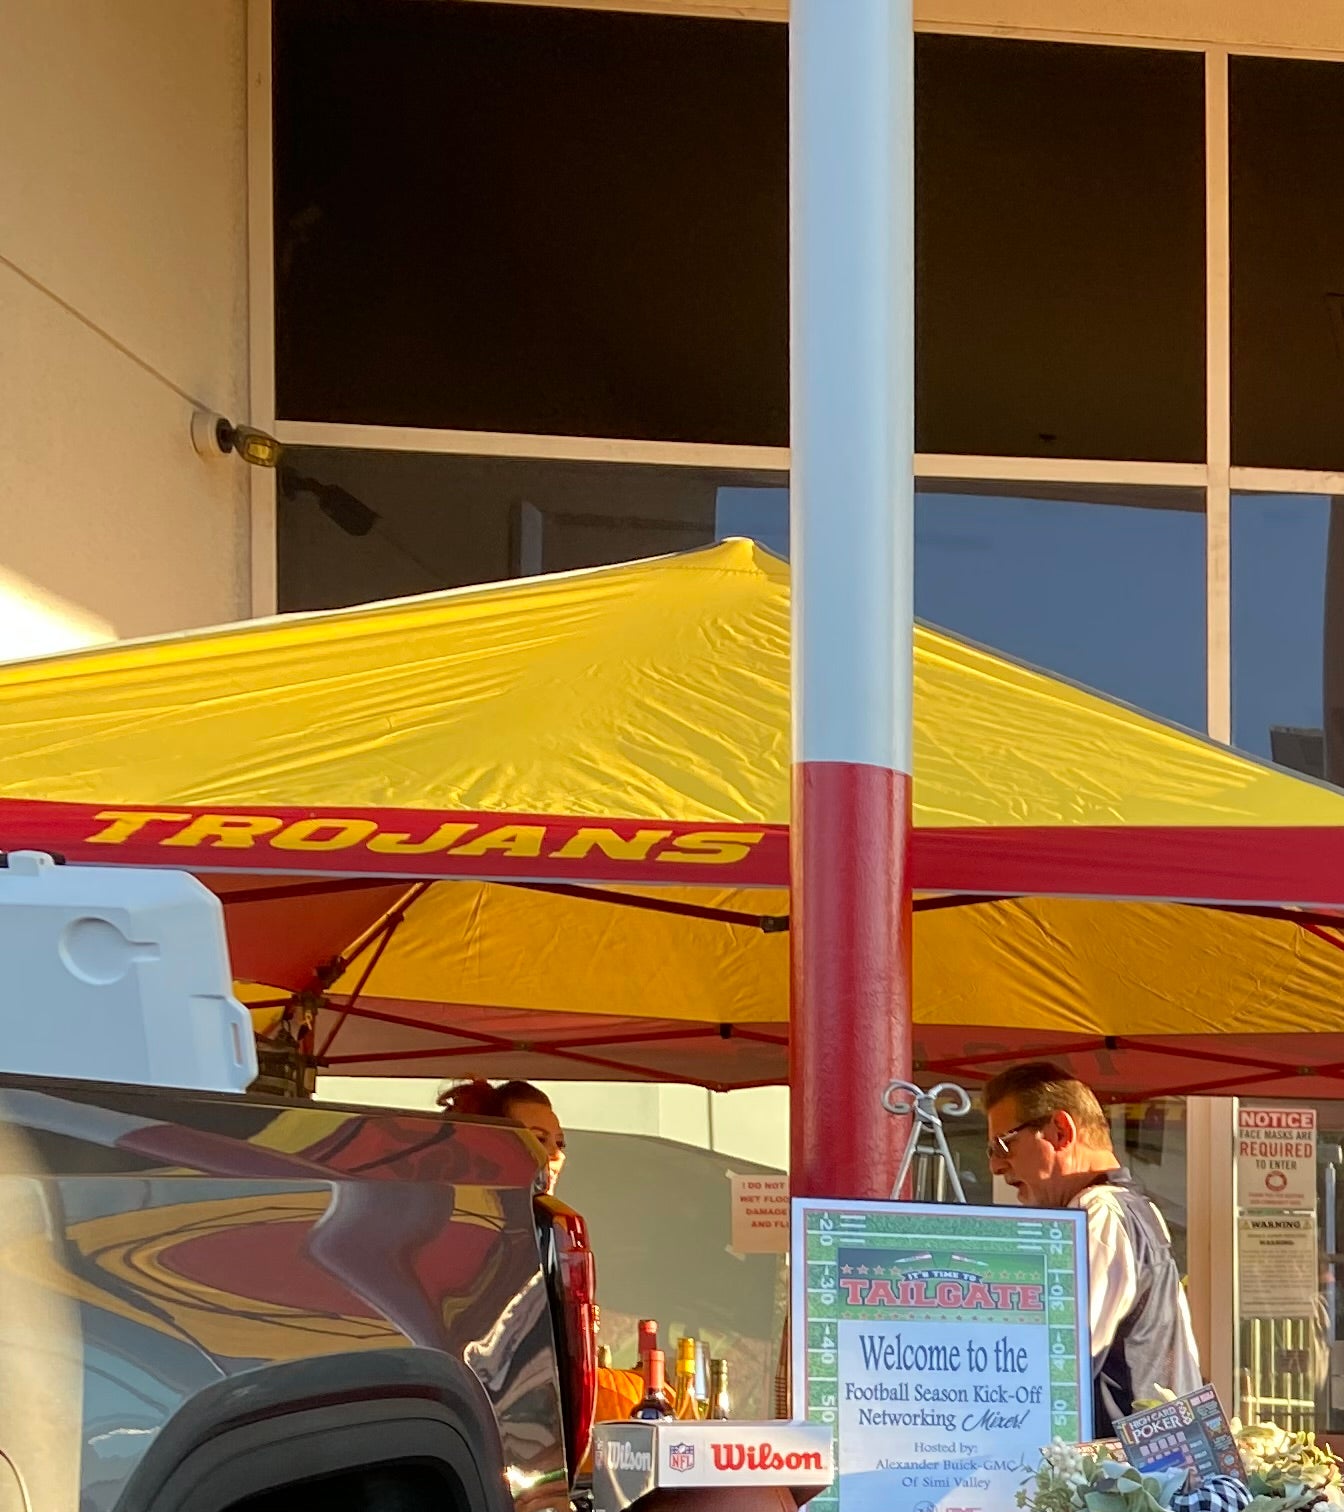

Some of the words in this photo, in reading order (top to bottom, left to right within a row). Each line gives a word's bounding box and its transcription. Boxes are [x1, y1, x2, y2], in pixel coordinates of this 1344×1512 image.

[84, 811, 766, 864] TROJANS
[1240, 1111, 1313, 1128] NOTICE
[1240, 1129, 1260, 1140] FACE
[1264, 1130, 1294, 1140] MASKS
[1296, 1131, 1313, 1141] ARE
[1240, 1141, 1313, 1158] REQUIRED
[1256, 1159, 1267, 1170] TO
[1269, 1160, 1297, 1171] ENTER
[764, 1181, 786, 1190] NOT
[745, 1208, 788, 1216] DAMAGE
[751, 1220, 772, 1228] AND
[1251, 1221, 1301, 1229] WARNING
[907, 1270, 929, 1282] IT'S
[931, 1269, 960, 1279] TIME
[962, 1272, 979, 1283] TO
[839, 1277, 1046, 1311] TAILGATE
[858, 1333, 961, 1373] Welcome
[966, 1339, 989, 1373] to
[993, 1335, 1029, 1374] the
[844, 1382, 910, 1402] Football
[913, 1384, 968, 1402] Season
[972, 1385, 1043, 1404] Kick-Off
[858, 1408, 957, 1431] Networking
[961, 1409, 1031, 1432] Mixer!
[1130, 1415, 1151, 1429] HIGH
[1151, 1406, 1178, 1420] CARD
[1131, 1414, 1183, 1444] POKER
[606, 1440, 652, 1472] Wilson
[710, 1442, 824, 1472] Wilson
[913, 1441, 956, 1454] Hosted
[959, 1441, 979, 1457] by:
[670, 1454, 695, 1470] NFL
[876, 1459, 940, 1471] Alexander
[943, 1459, 1017, 1471] Buick-GMC
[901, 1476, 921, 1488] Of
[923, 1476, 951, 1488] Simi
[953, 1476, 991, 1490] Valley
